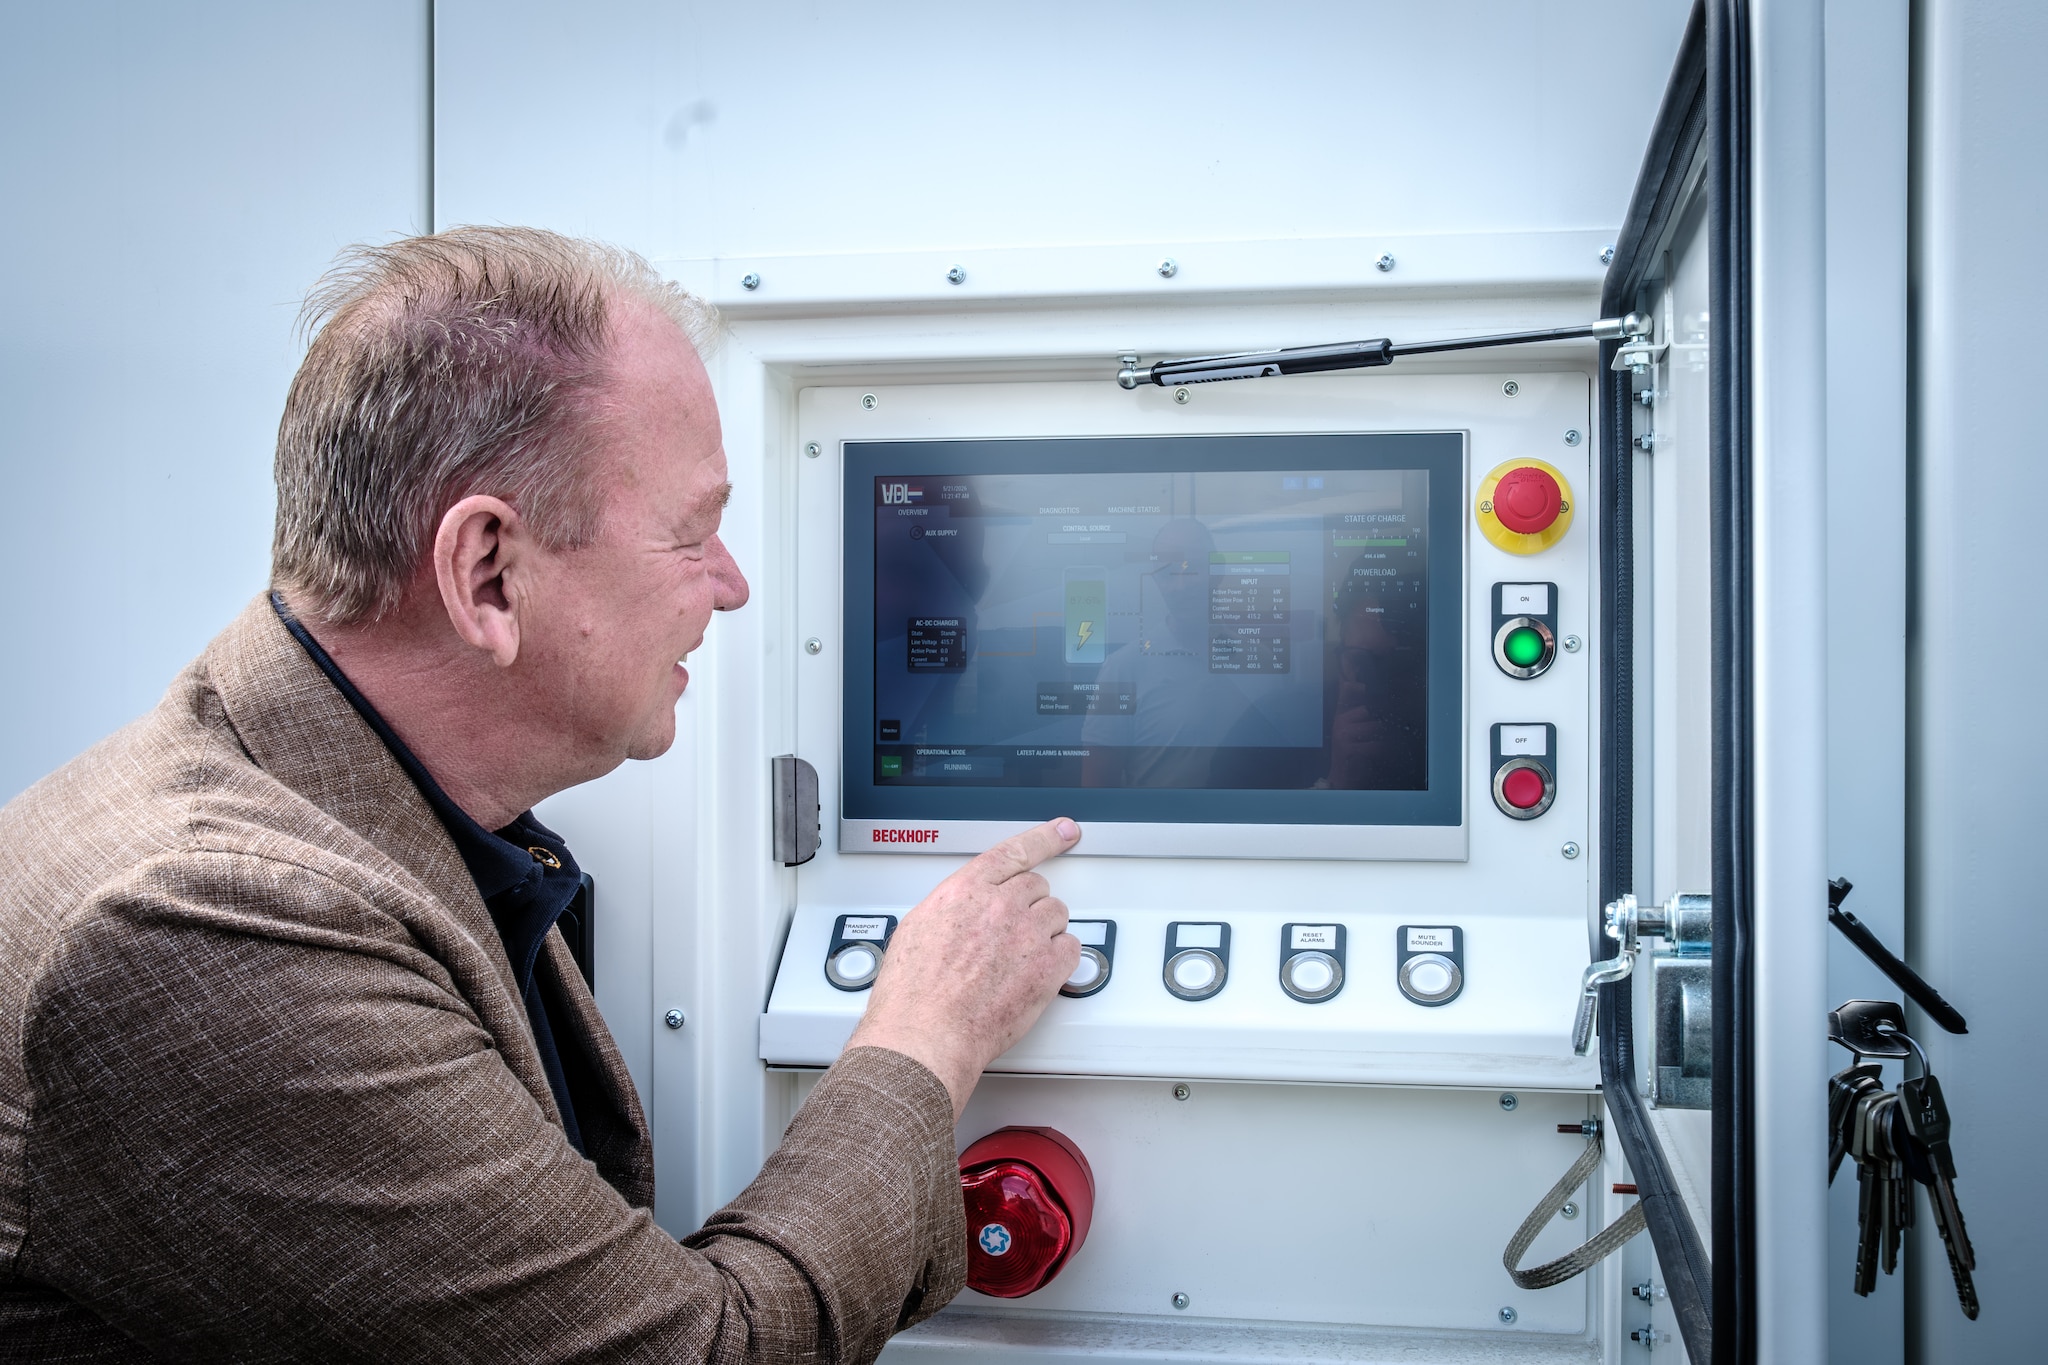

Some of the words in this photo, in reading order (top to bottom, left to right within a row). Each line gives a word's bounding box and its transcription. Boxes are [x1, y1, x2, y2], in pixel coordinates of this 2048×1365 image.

[1344, 515, 1366, 523] STATE
[1366, 515, 1376, 523] OF
[1377, 515, 1406, 523] CHARGE
[1353, 568, 1397, 576] POWERLOAD
[944, 763, 972, 771] RUNNING
[872, 829, 939, 843] BECKHOFF
